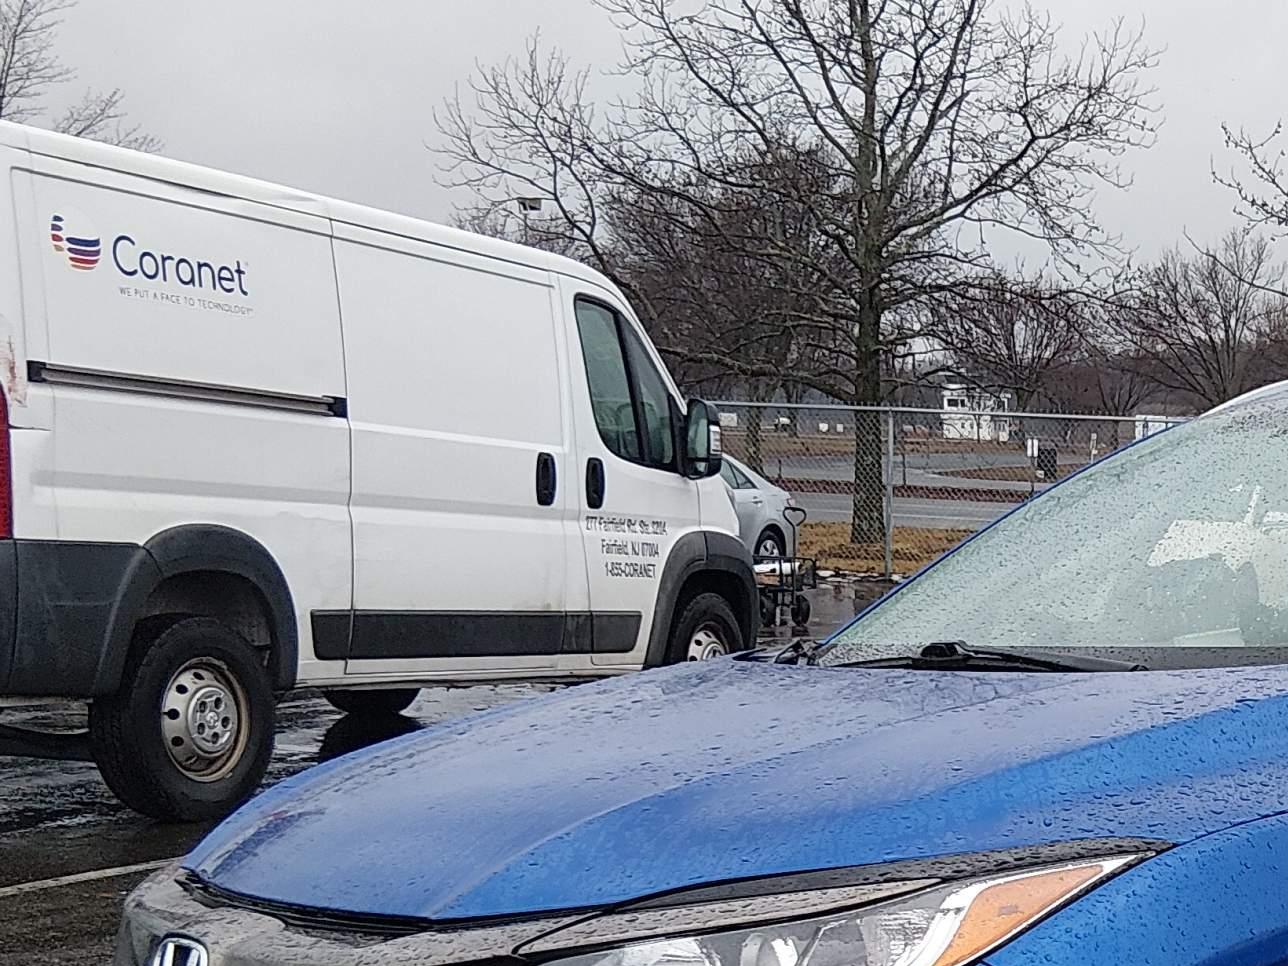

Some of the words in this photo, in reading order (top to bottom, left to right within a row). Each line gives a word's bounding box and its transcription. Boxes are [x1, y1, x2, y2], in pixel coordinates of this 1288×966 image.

[112, 235, 249, 296] Coranet
[119, 287, 132, 297] WE
[134, 288, 149, 299] PUT
[153, 292, 159, 300] A
[160, 292, 181, 305] FACE
[184, 296, 195, 306] TO
[598, 516, 626, 533] Fairfield
[631, 540, 640, 556] NJ
[605, 561, 656, 578] 1-855-CORANET
